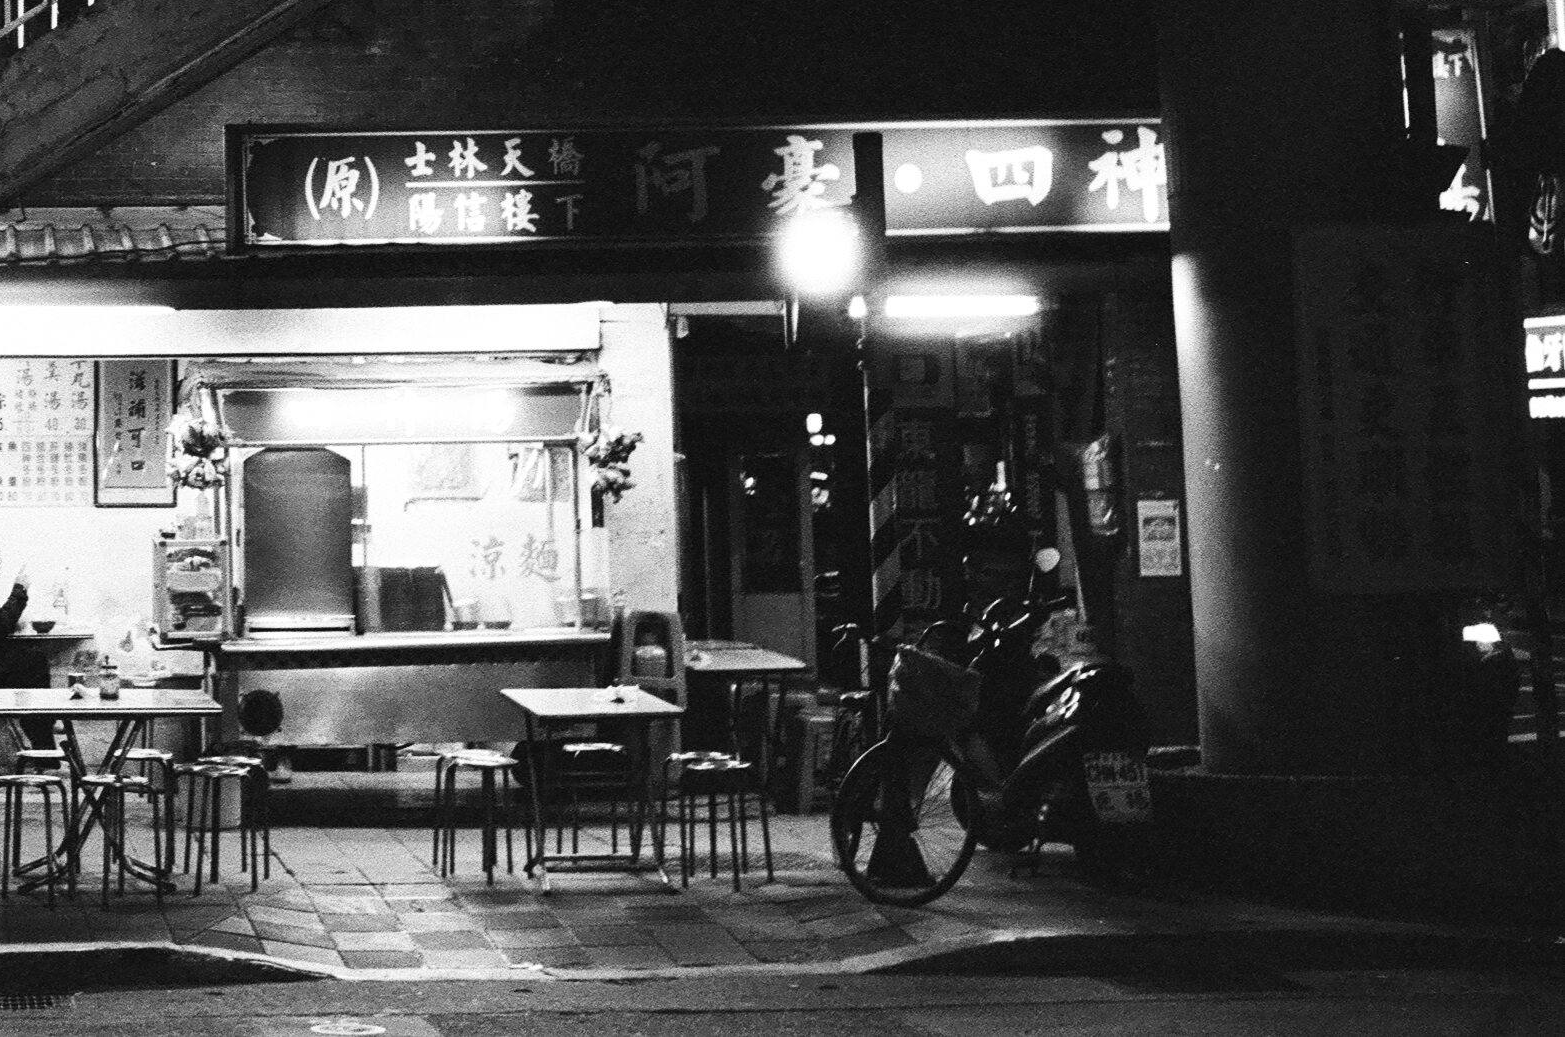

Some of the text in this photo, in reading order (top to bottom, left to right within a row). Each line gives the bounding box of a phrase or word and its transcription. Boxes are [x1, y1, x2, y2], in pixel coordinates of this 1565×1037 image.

[403, 137, 585, 181] 士林天橋
[406, 188, 585, 234] 陽信樓下
[468, 532, 563, 583] 涼麵
